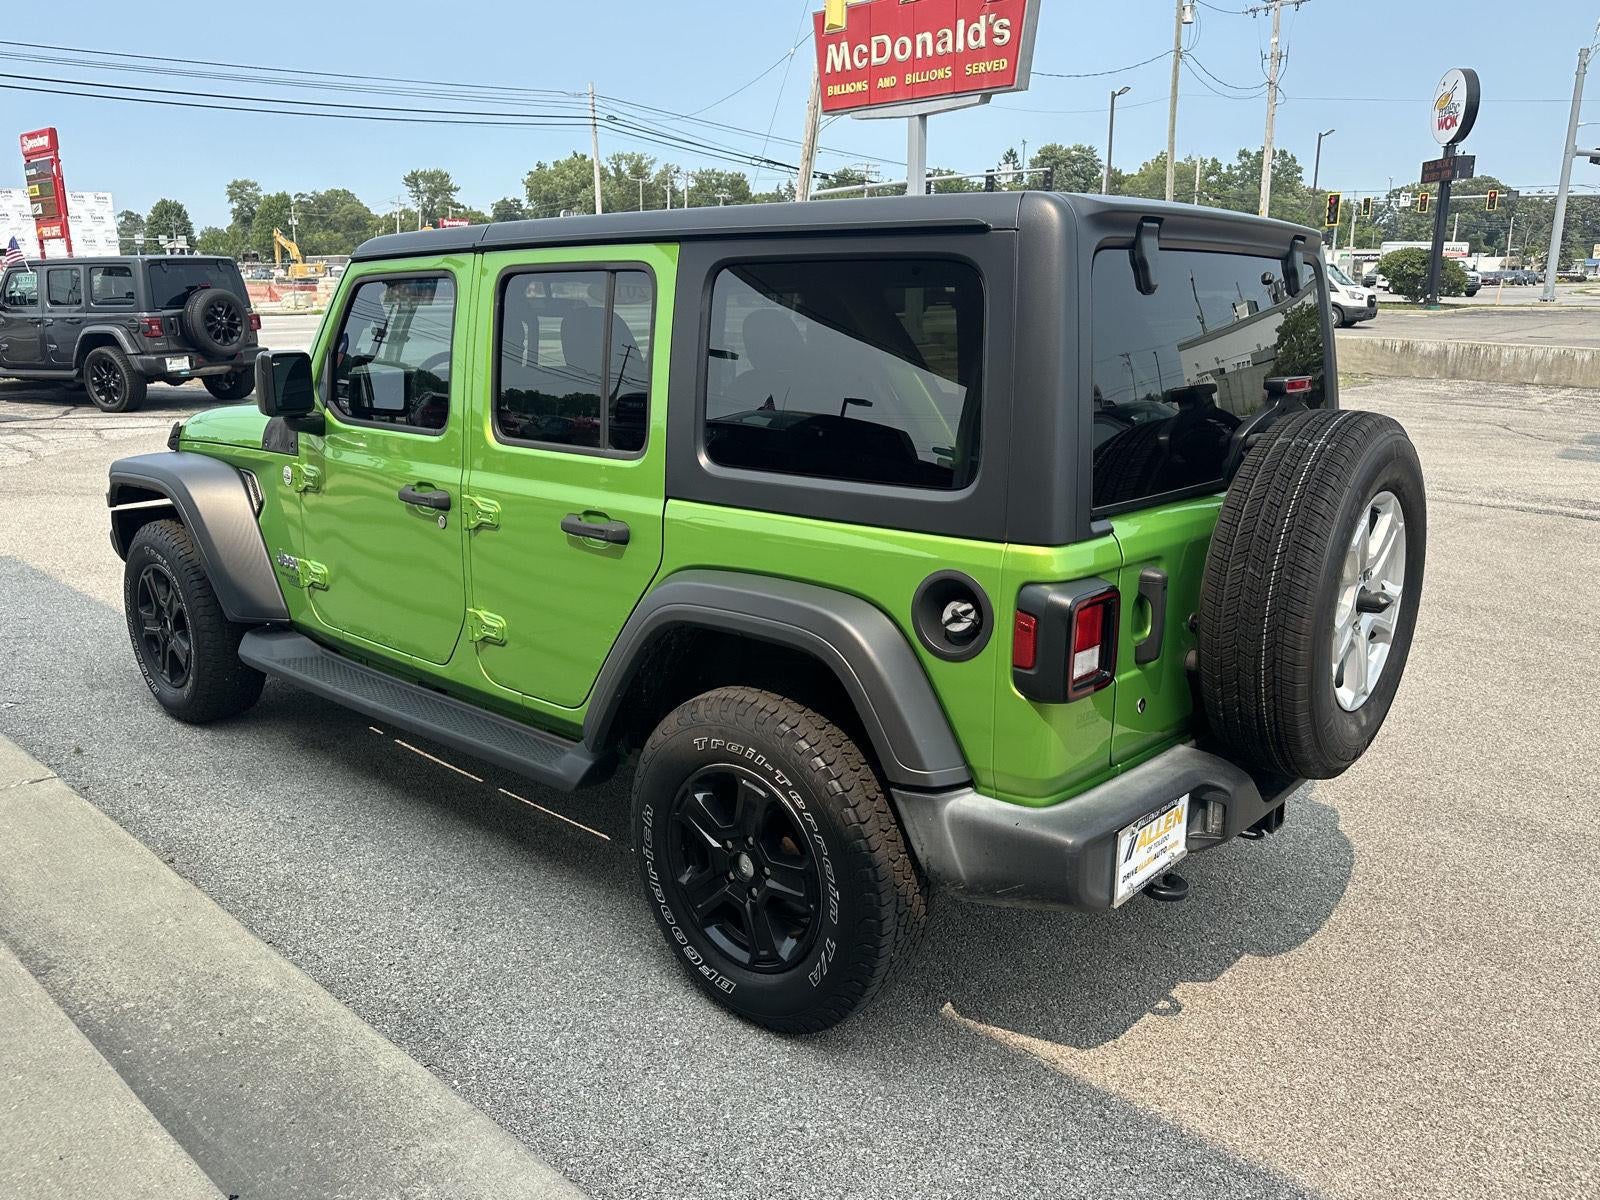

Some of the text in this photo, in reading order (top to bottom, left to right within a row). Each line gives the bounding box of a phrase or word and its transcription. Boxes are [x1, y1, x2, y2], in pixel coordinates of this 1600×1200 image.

[825, 13, 1011, 74] McDonald's
[827, 58, 1008, 96] BILLIONS AND BILLIONS SERVED
[1437, 114, 1459, 131] WOK
[1136, 803, 1185, 853] ALLEN
[642, 803, 736, 994] BFGoodrich
